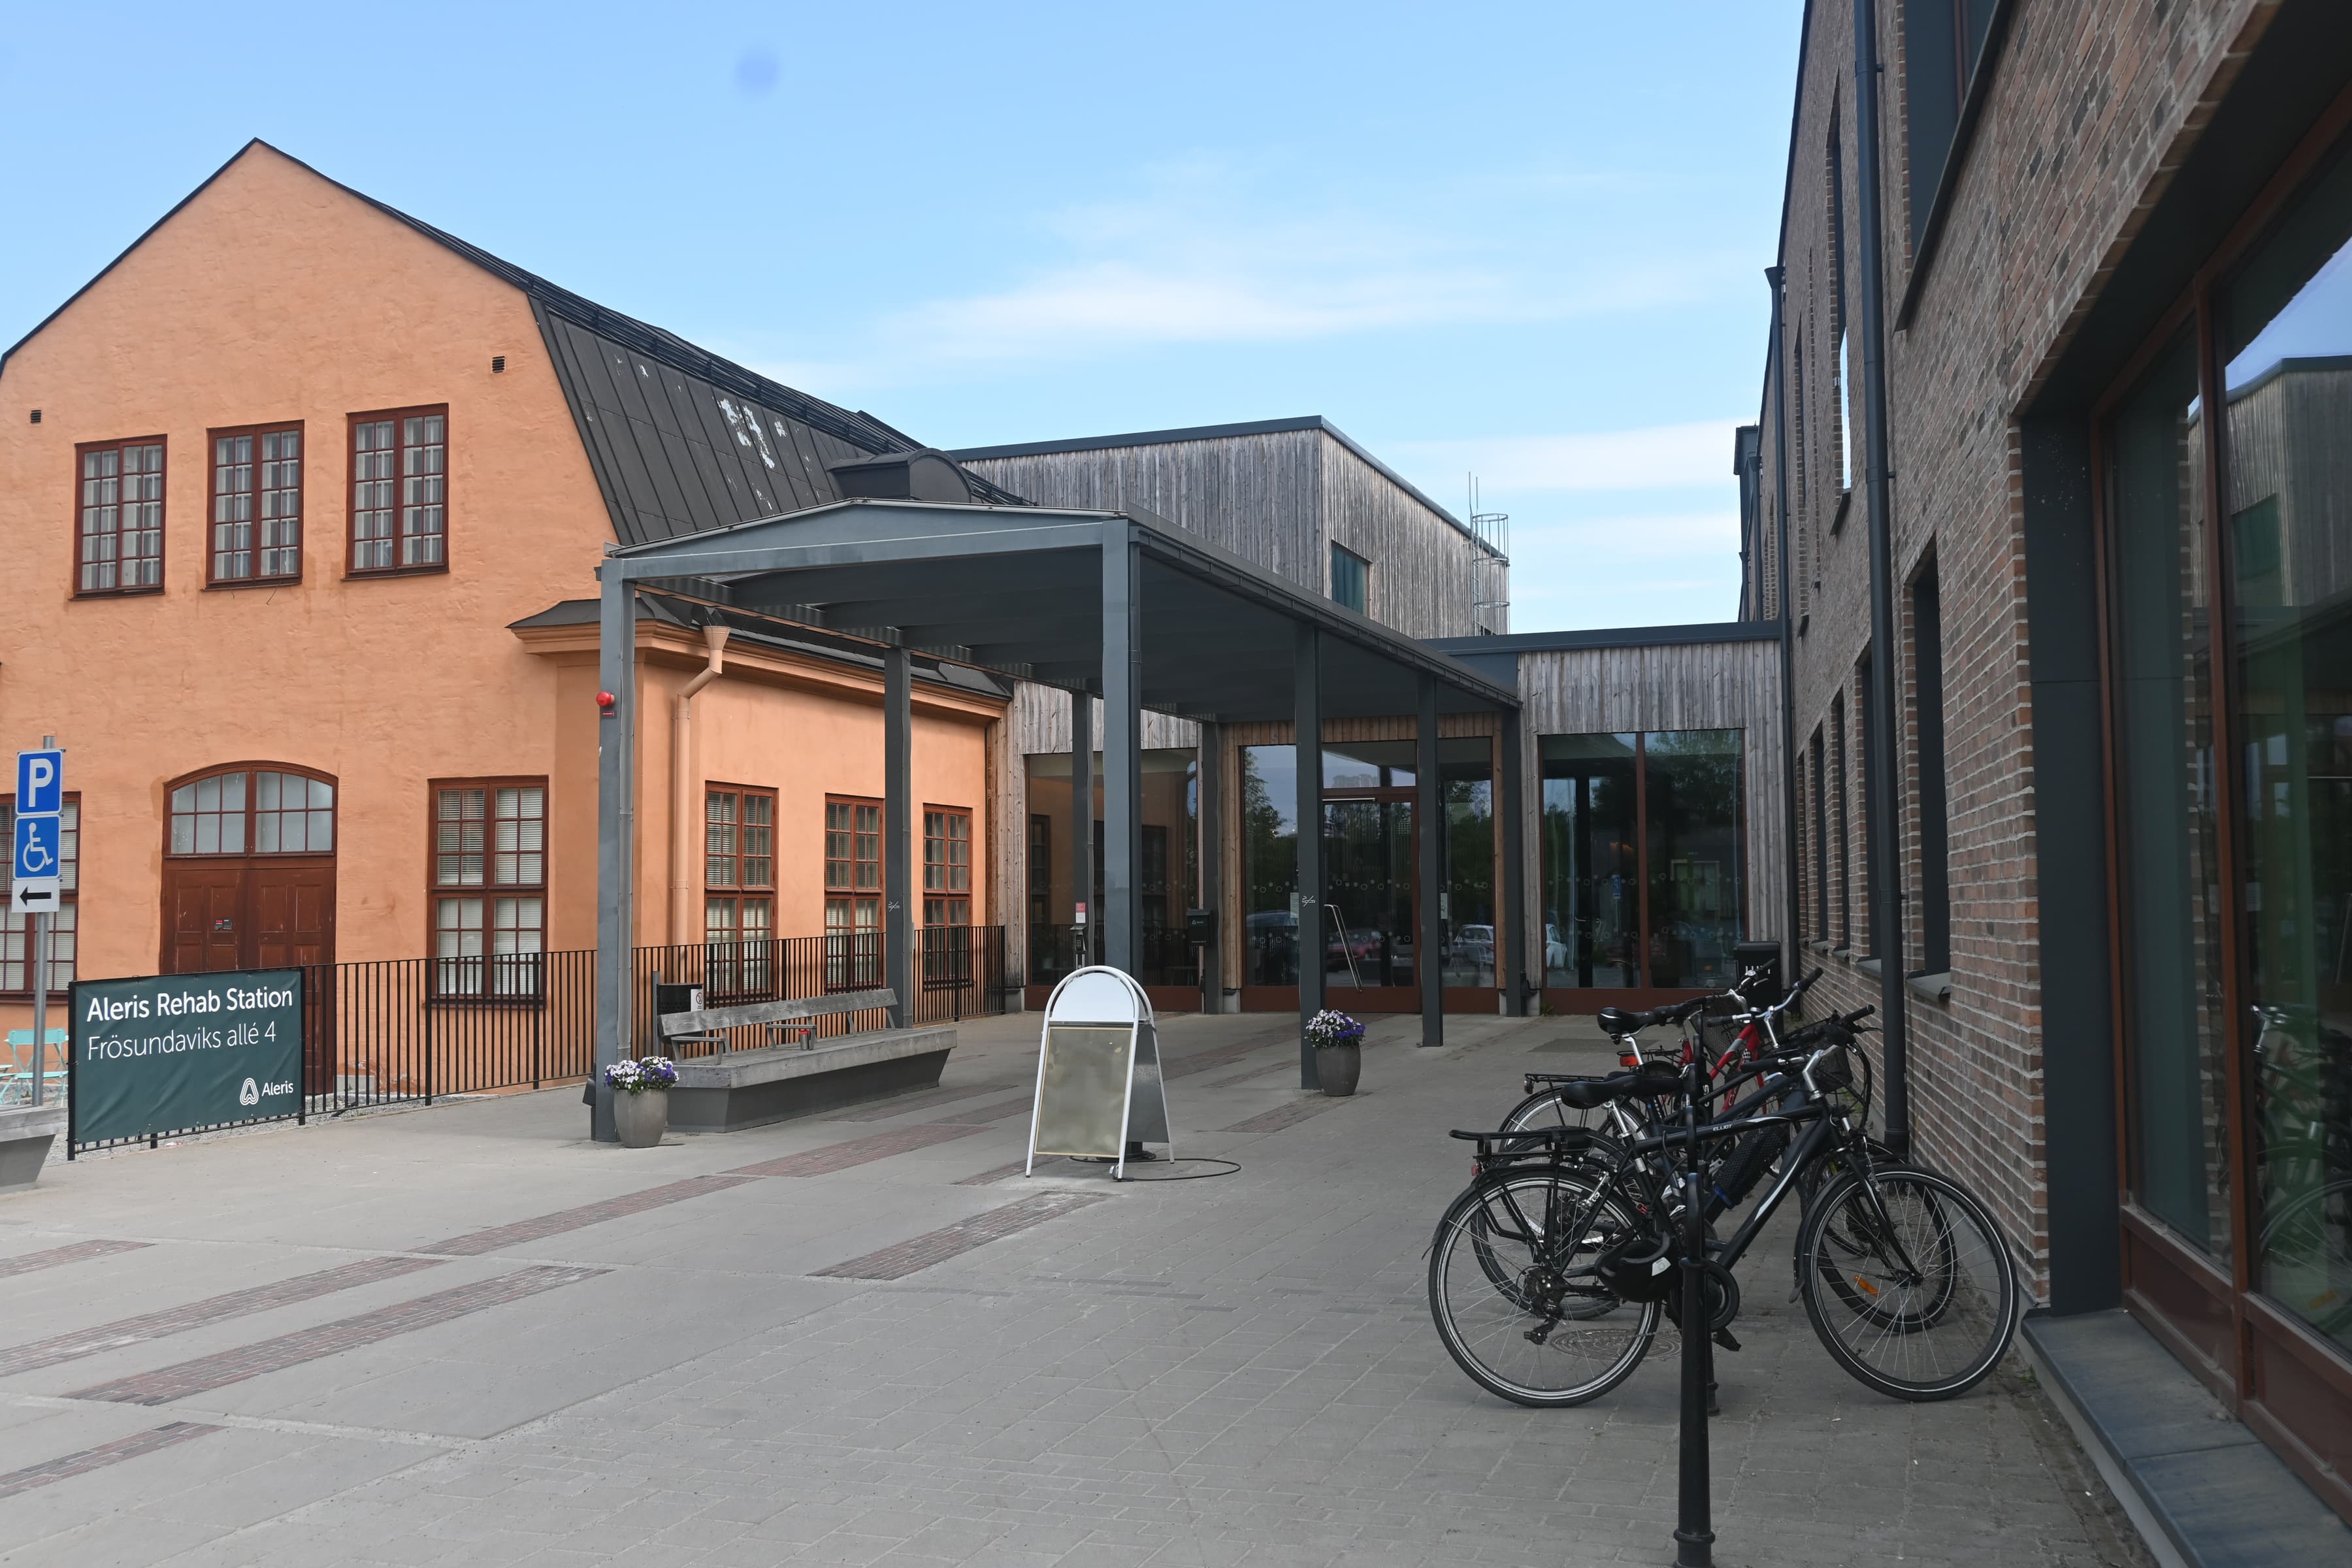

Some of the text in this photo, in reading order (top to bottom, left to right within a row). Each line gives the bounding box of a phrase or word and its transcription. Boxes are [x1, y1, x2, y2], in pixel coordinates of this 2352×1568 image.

[28, 758, 54, 808] P
[86, 985, 293, 1022] Aleris Rehab Station
[88, 1021, 276, 1061] Frösundaviks allé 4
[261, 1080, 294, 1097] Aleris
